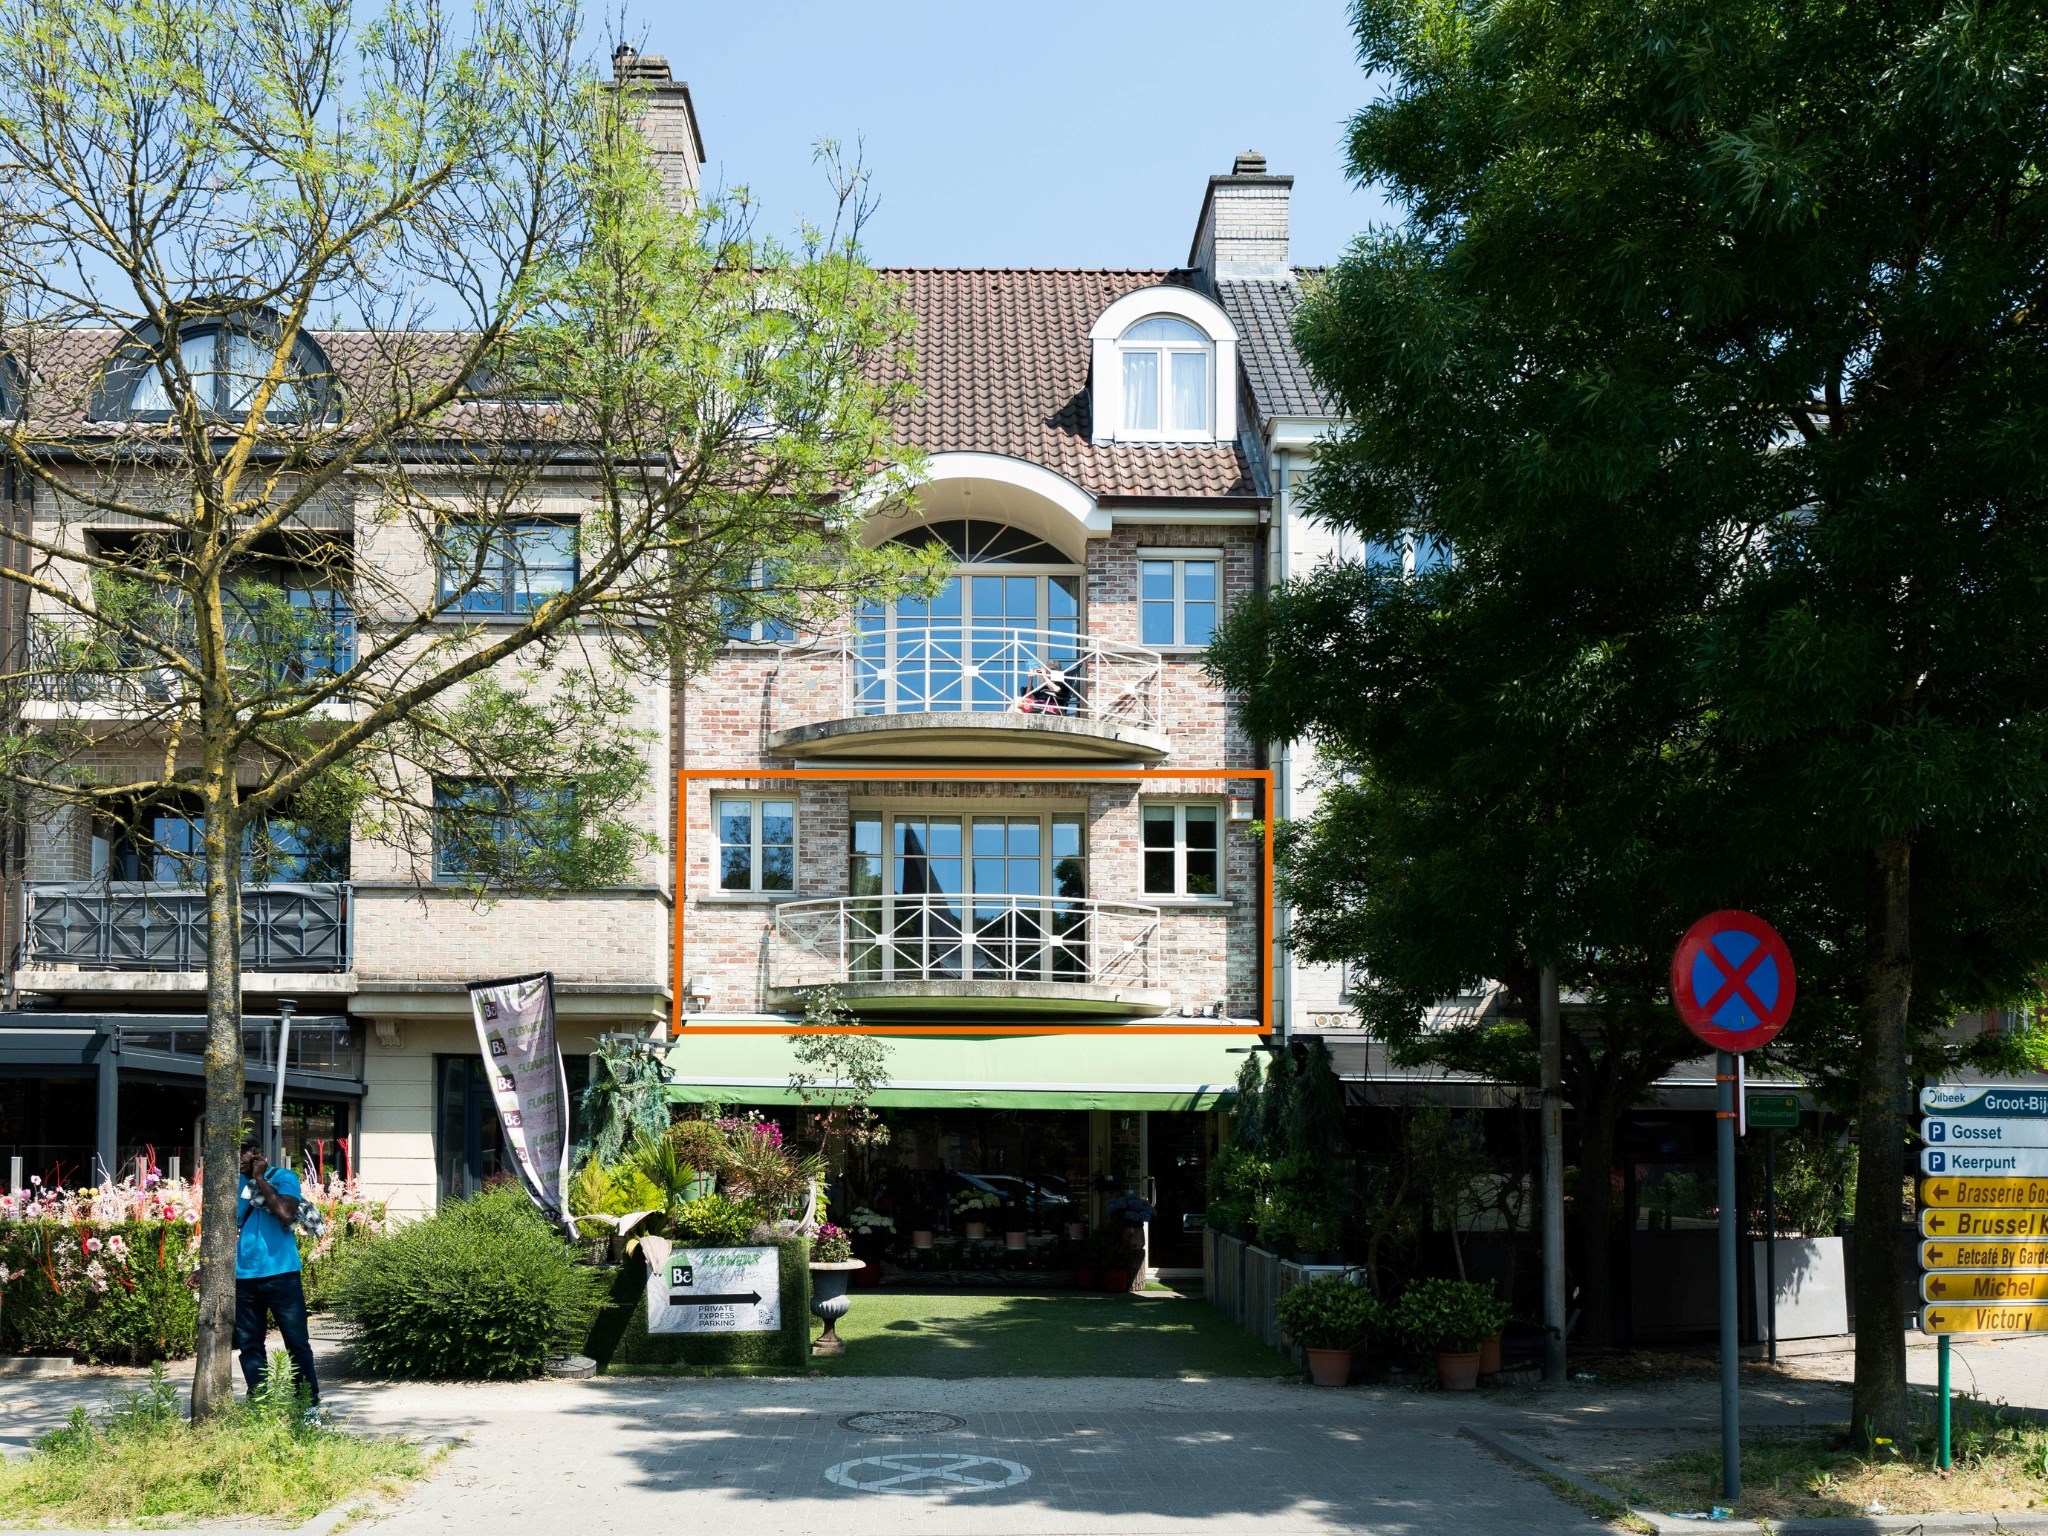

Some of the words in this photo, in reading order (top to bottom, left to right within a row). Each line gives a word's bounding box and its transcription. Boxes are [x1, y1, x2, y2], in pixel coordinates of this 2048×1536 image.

[1984, 1095, 2048, 1114] Groot-Bij
[1952, 1125, 2002, 1139] Gosset
[1952, 1154, 2016, 1172] Keerpunt
[1957, 1182, 2024, 1203] Brasserie
[1957, 1213, 2035, 1234] Brussel
[1957, 1247, 1998, 1265] Eetcafé
[2001, 1248, 2015, 1267] By
[1973, 1278, 2035, 1296] Michel
[1976, 1308, 2033, 1331] Victory
